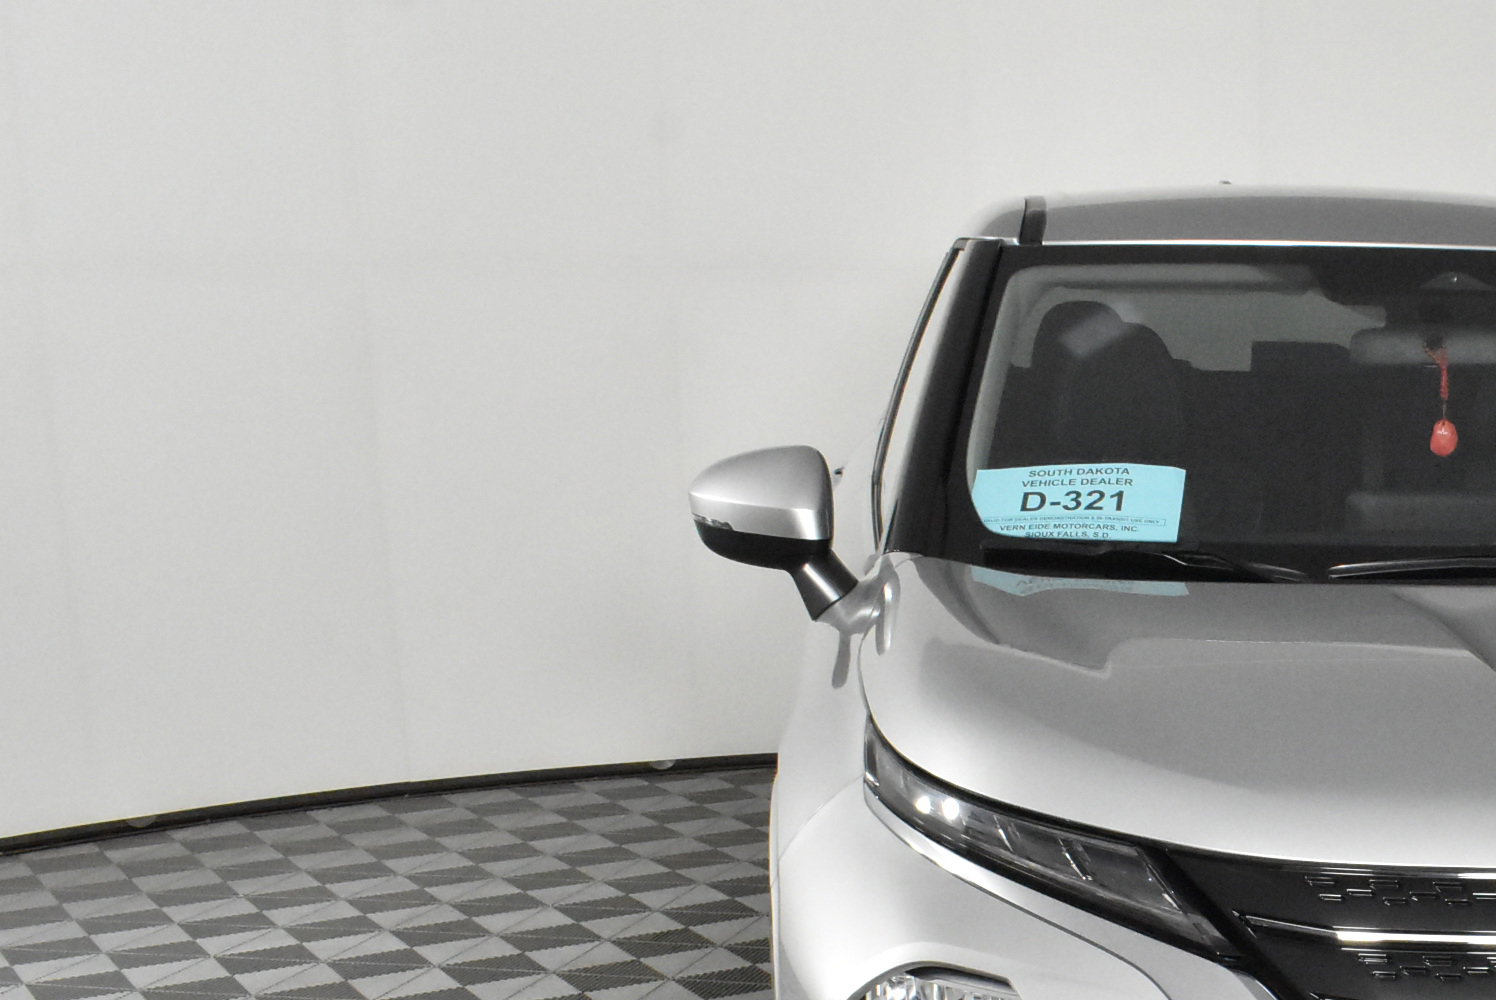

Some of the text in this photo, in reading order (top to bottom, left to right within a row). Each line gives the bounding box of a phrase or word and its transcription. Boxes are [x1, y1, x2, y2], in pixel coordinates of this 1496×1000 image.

[1028, 466, 1130, 477] SOUTH DAKOTA
[1021, 477, 1133, 488] VEHICLE DEALER
[1020, 489, 1125, 511] D-321
